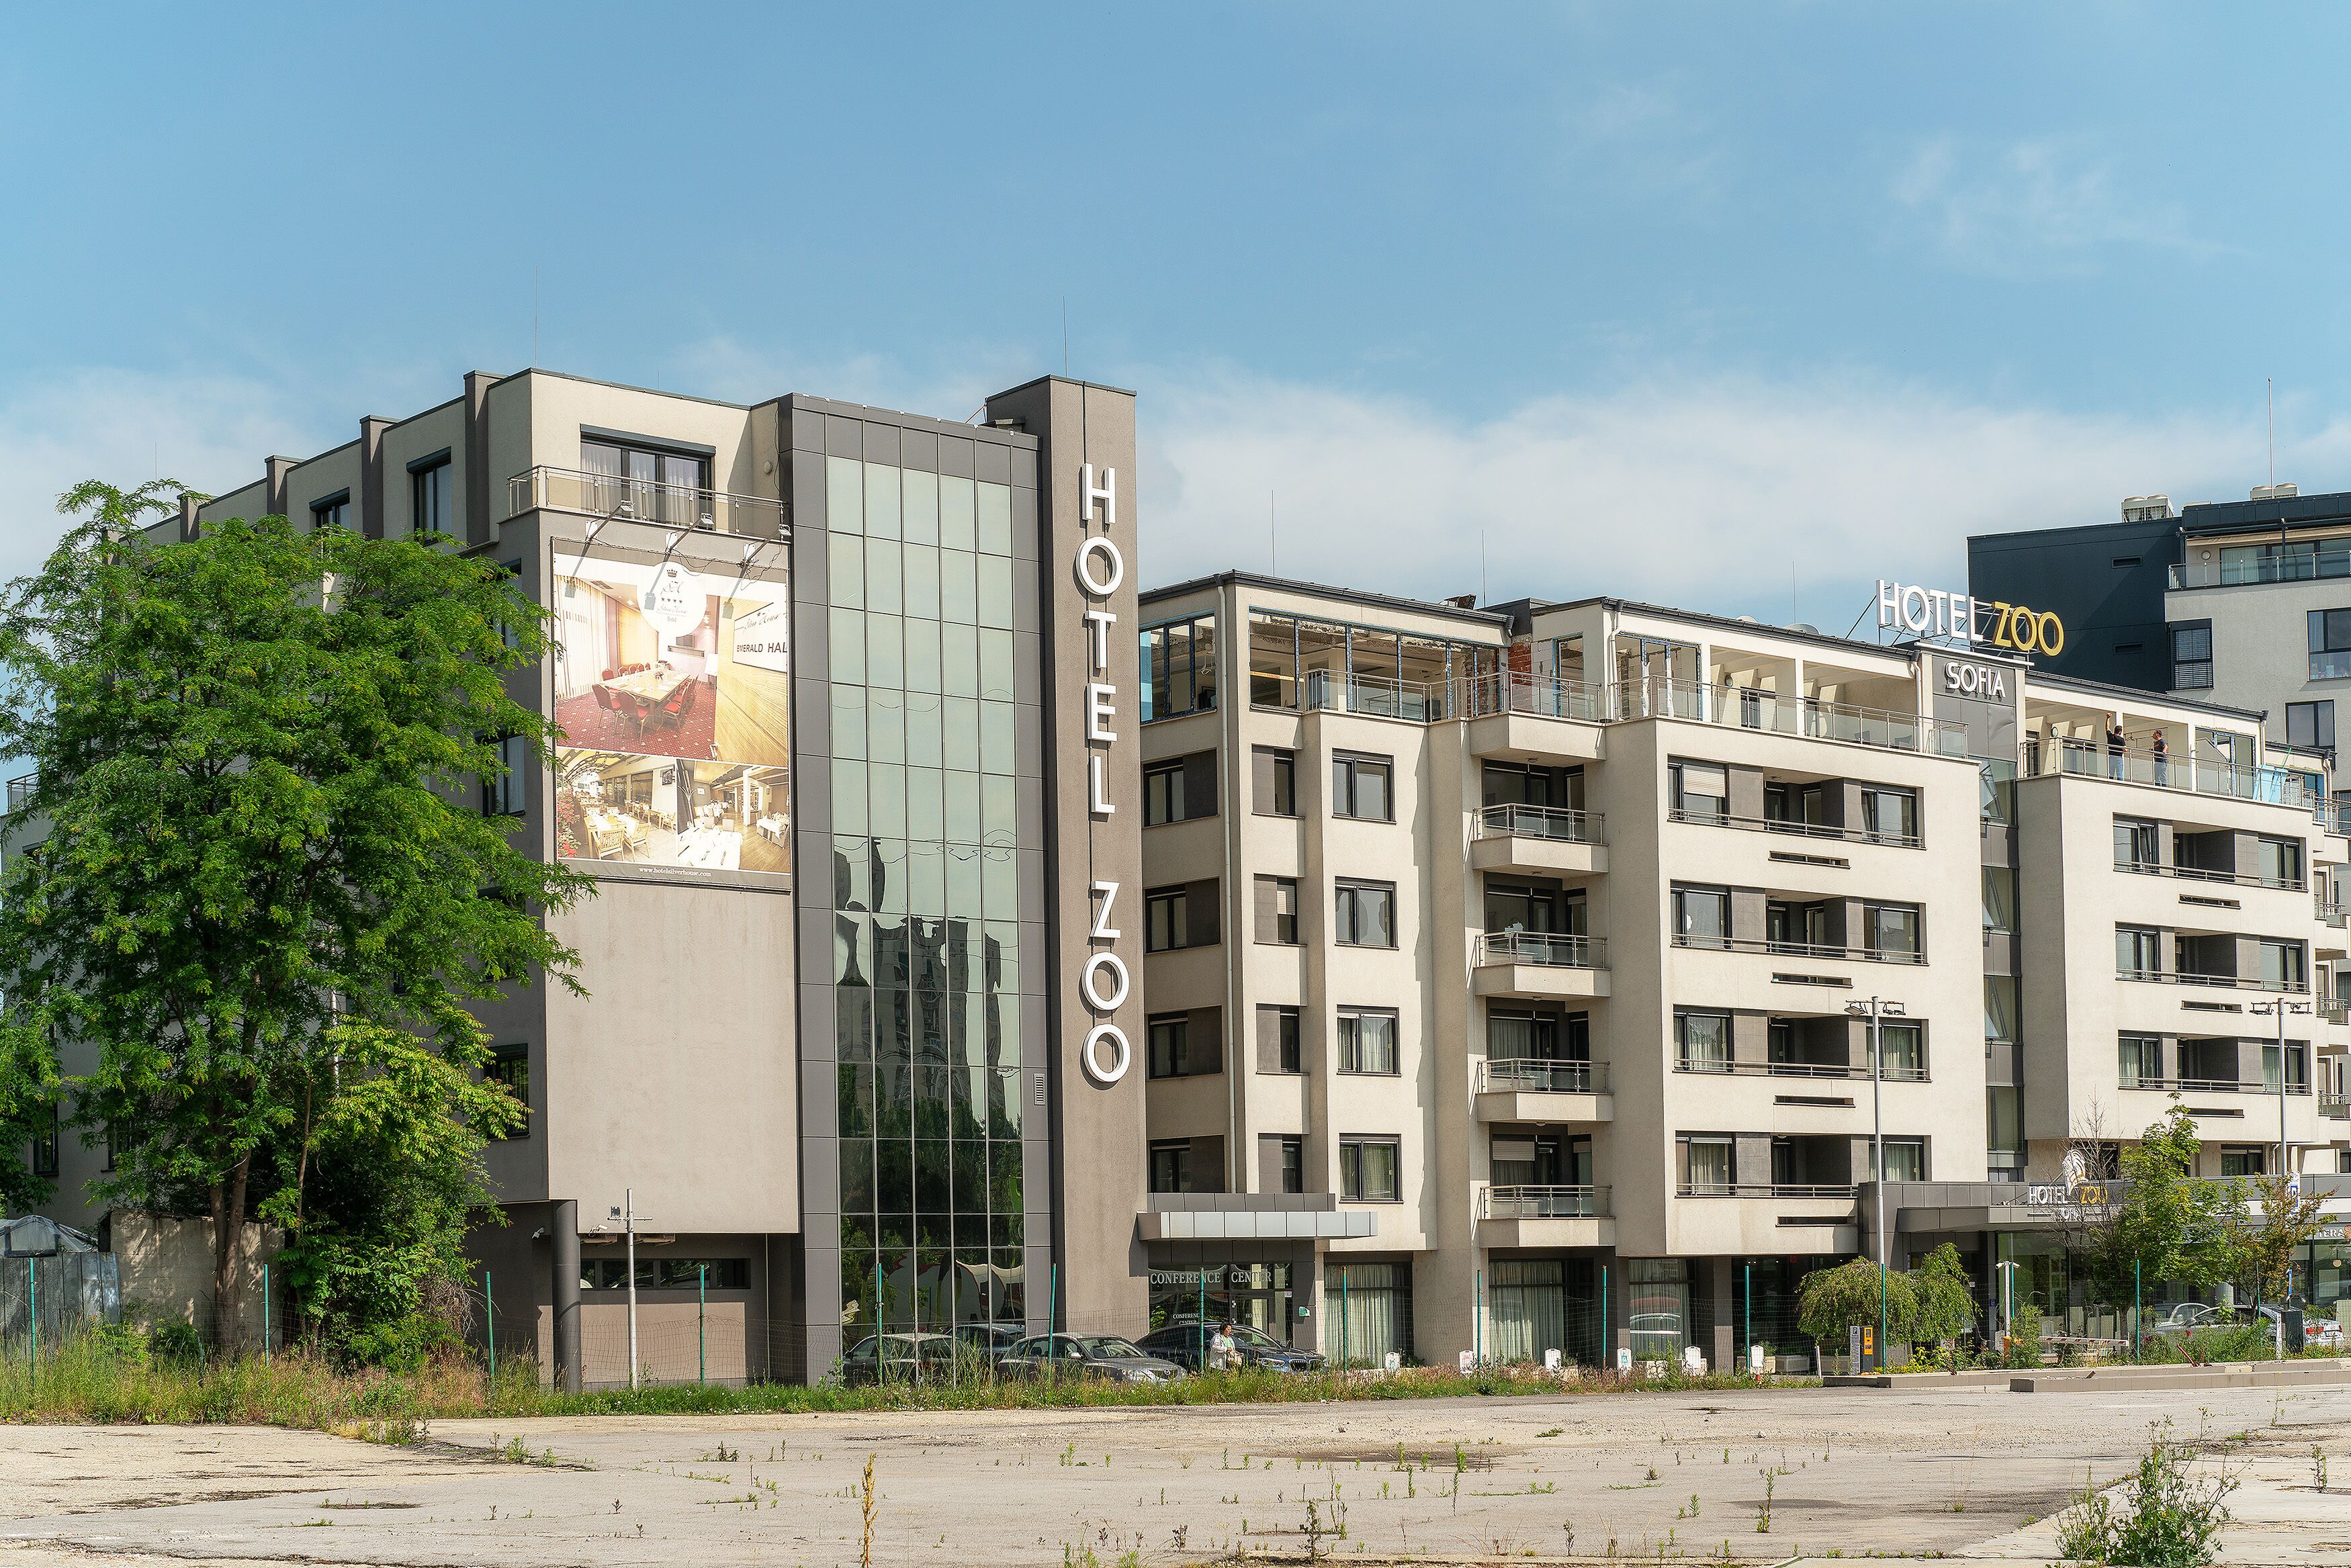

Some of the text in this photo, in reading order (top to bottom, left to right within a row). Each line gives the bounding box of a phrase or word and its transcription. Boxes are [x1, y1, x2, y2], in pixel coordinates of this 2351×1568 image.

[1876, 580, 2064, 656] HOTEL ZOO
[736, 643, 764, 653] EMERALD
[1946, 661, 2006, 698] SOFIA
[1076, 463, 1131, 1083] HOTEL ZOO
[639, 867, 712, 877] www.hotelsilverhouse.com
[2029, 1185, 2108, 1204] HOTEL ZOO
[1150, 1271, 1272, 1284] CONFERENCE CENTER
